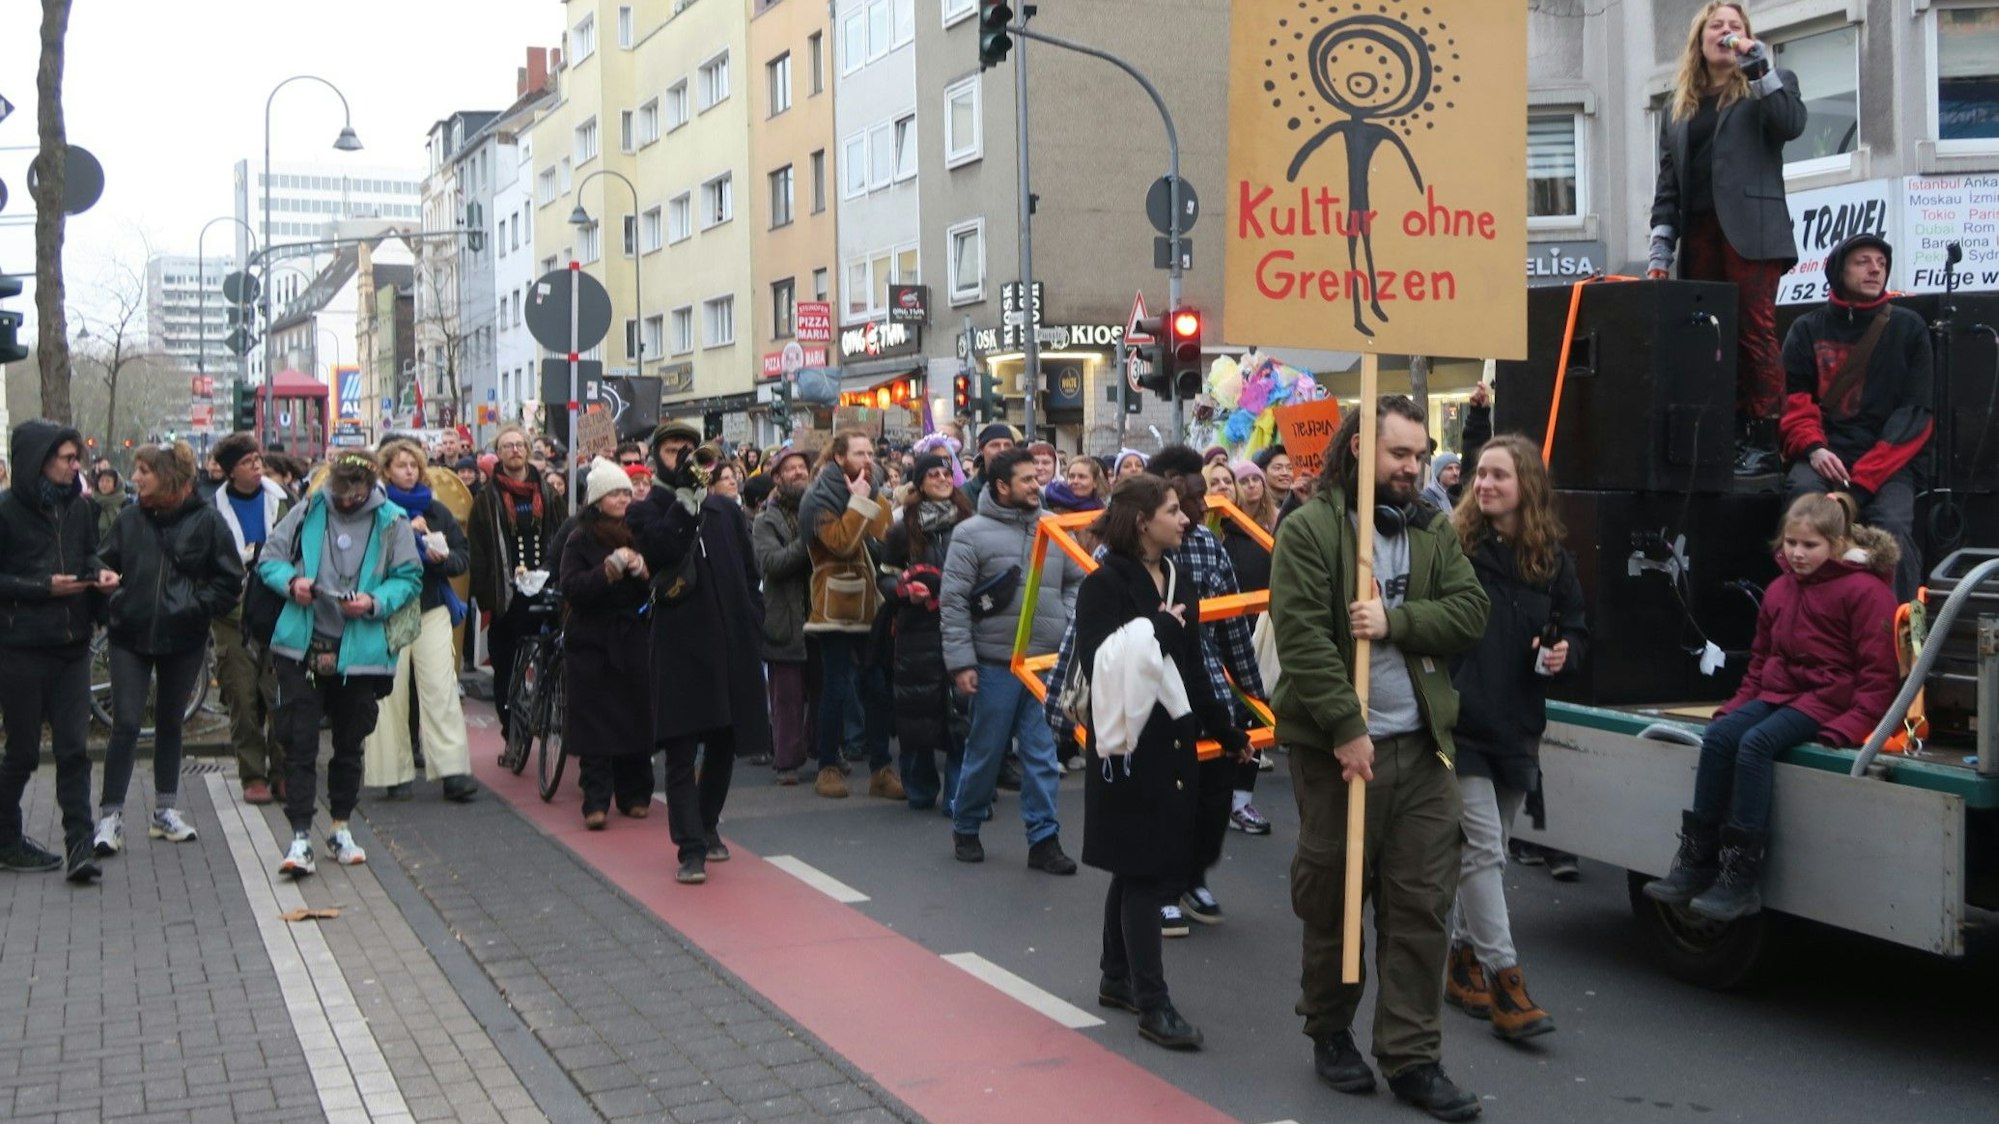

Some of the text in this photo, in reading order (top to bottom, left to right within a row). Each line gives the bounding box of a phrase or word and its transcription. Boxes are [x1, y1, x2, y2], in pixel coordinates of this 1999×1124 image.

[1909, 194, 1962, 206] Moskau
[1239, 180, 1496, 240] Kultur ohne
[1921, 209, 1956, 221] Tokio
[1803, 199, 1887, 251] TRAVEL
[1915, 222, 1995, 235] Dubai Rom
[1800, 258, 1819, 273] ein
[1255, 249, 1456, 302] Grenzen
[1914, 268, 1974, 290] Flüge
[1791, 283, 1815, 301] 52
[798, 316, 829, 328] PIZZA
[798, 329, 830, 340] MARIA
[1071, 325, 1124, 345] KIOS
[280, 414, 291, 427] U
